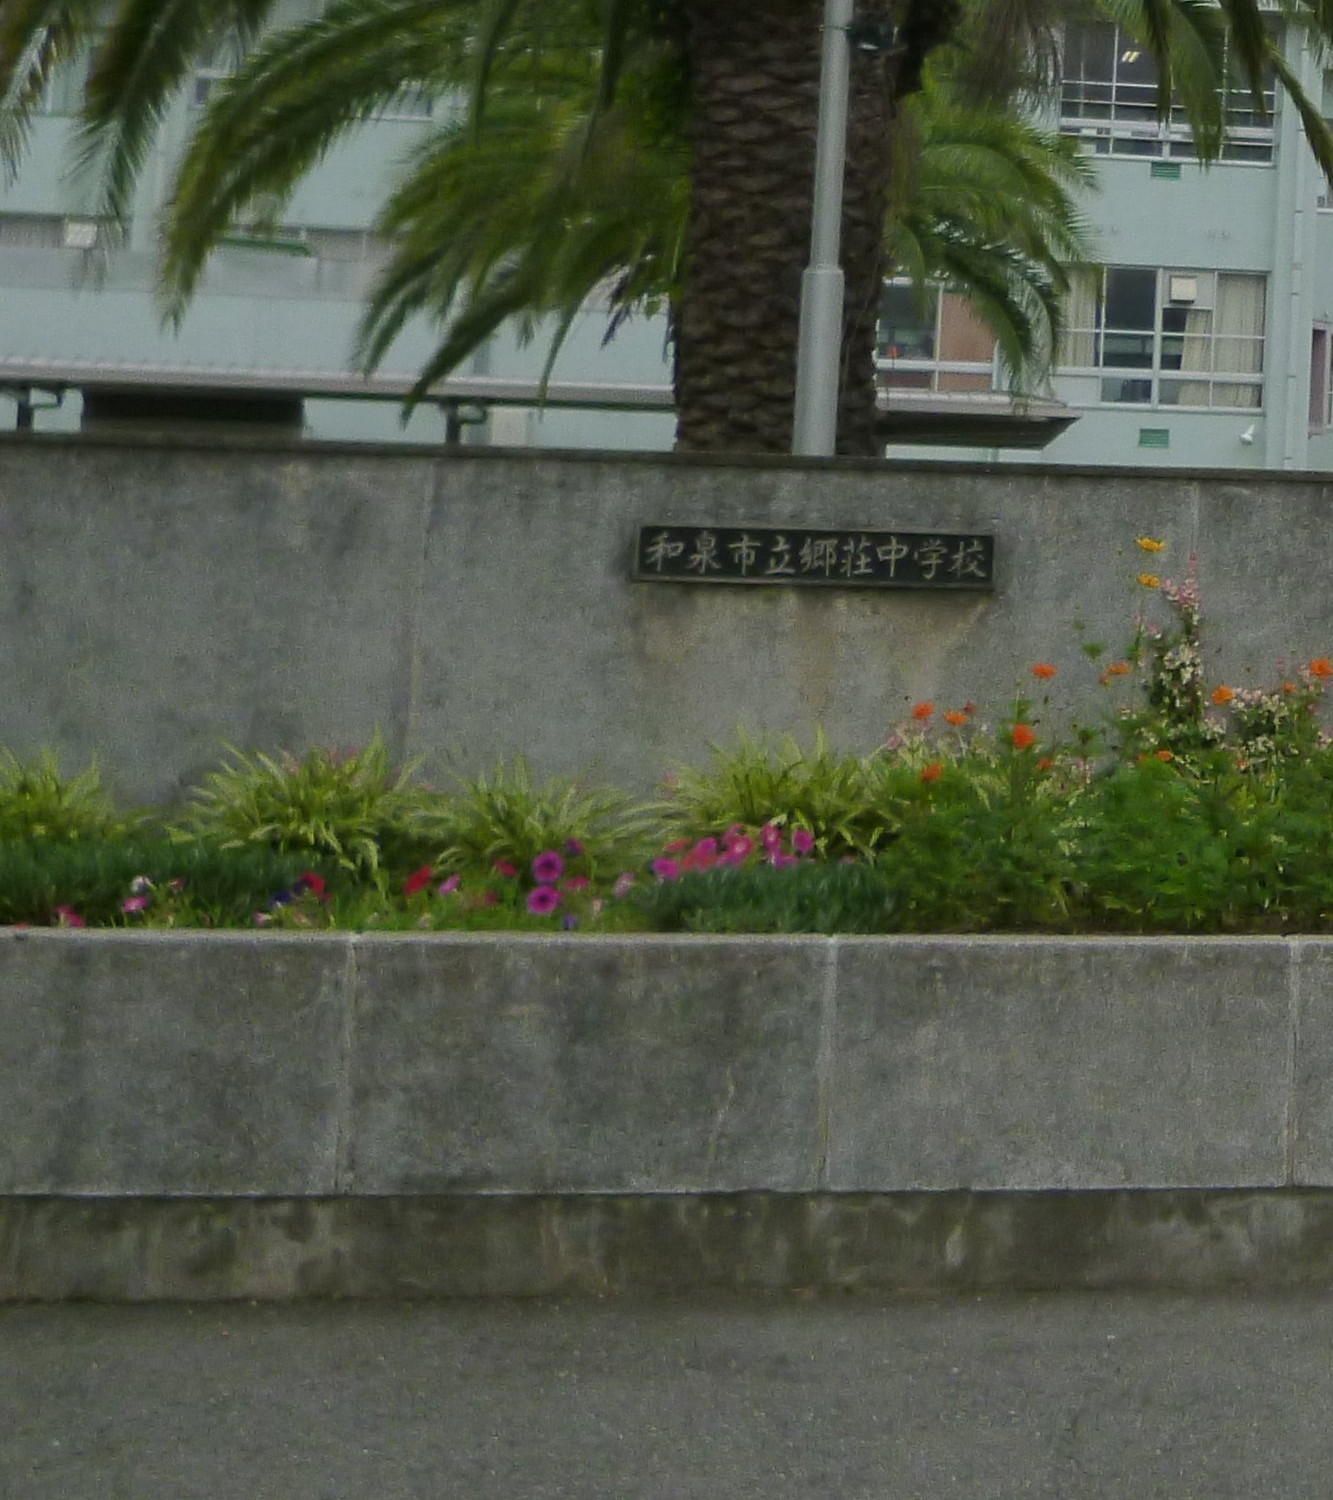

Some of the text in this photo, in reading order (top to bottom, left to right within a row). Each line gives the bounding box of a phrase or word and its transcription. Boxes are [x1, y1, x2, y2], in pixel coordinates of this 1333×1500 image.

[645, 531, 986, 579] 和泉市立郷荘中学校
